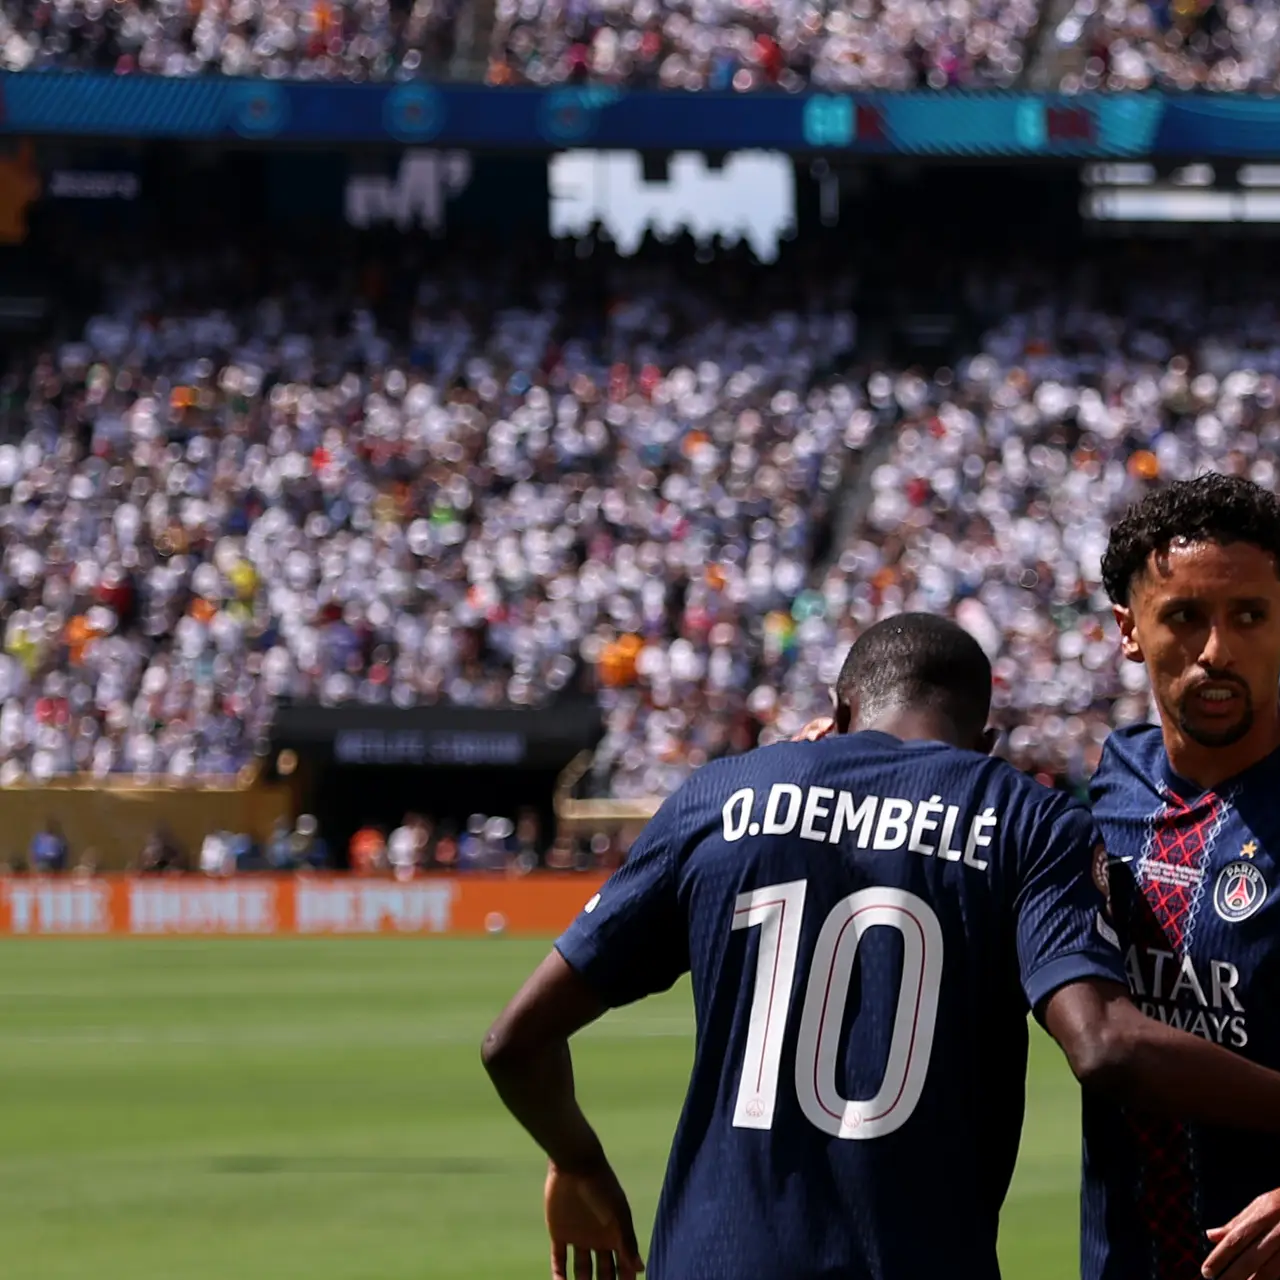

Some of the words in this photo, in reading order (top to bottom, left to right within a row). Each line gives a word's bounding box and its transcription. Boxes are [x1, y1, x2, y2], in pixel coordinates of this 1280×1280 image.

[722, 783, 997, 870] O.DEMBÉLÉ
[731, 879, 944, 1140] 10
[1124, 944, 1245, 1013] ATAR
